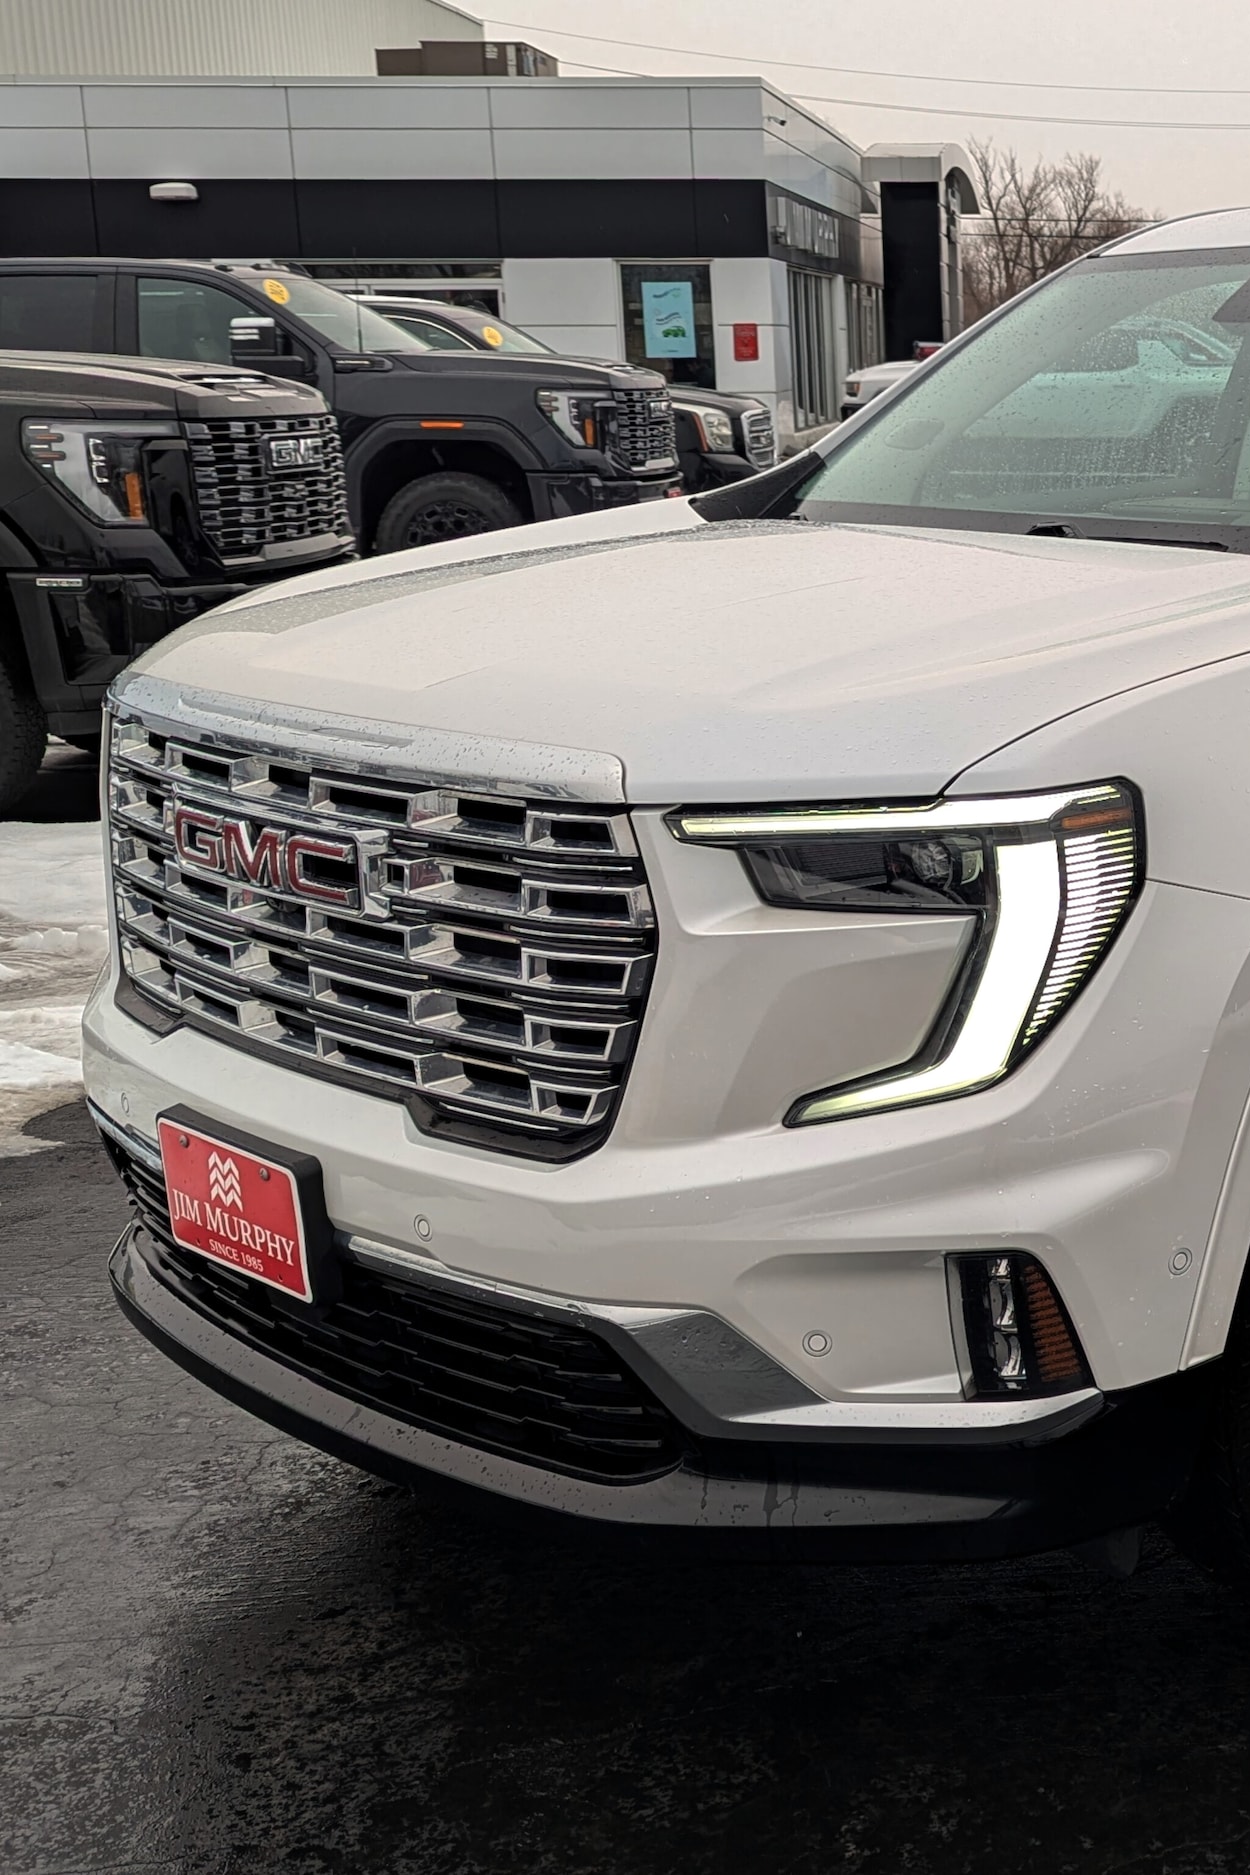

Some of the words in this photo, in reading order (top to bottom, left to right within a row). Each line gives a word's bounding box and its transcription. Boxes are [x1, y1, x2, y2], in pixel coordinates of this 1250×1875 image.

[174, 805, 359, 905] GMC
[172, 1188, 203, 1226] JIM
[203, 1202, 295, 1267] MURPHY
[209, 1239, 240, 1262] SINCE
[240, 1252, 264, 1272] 1985
